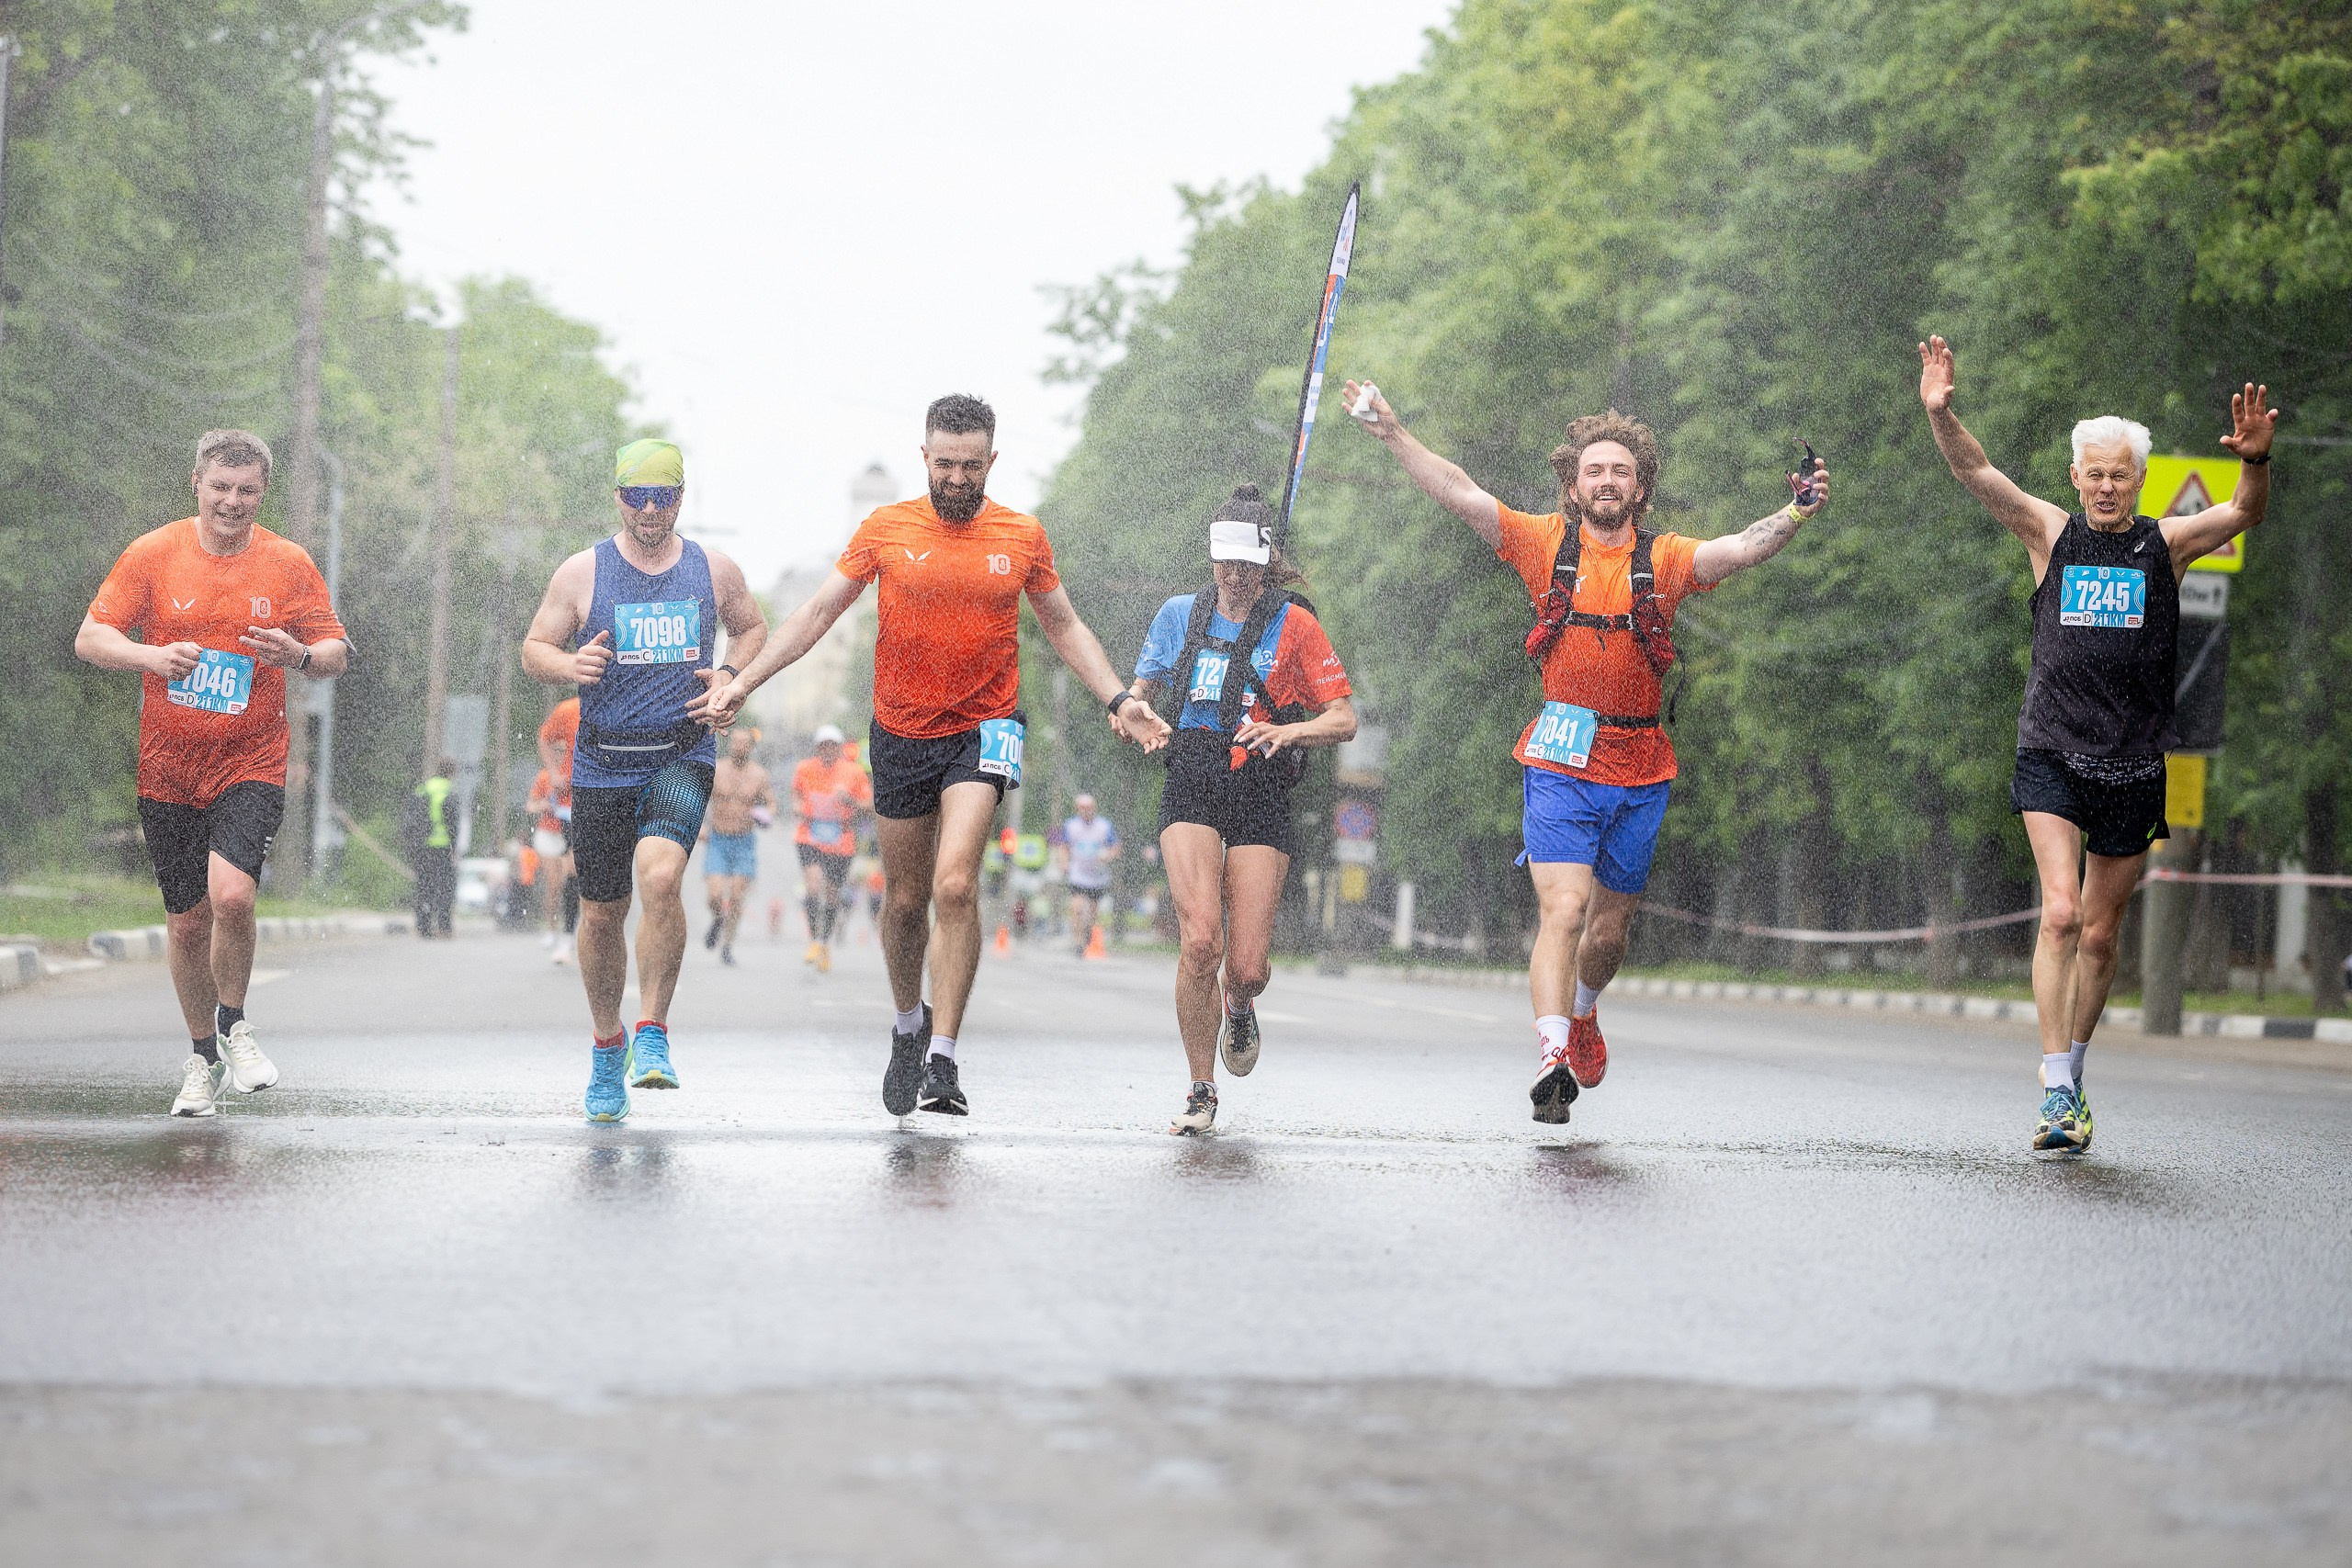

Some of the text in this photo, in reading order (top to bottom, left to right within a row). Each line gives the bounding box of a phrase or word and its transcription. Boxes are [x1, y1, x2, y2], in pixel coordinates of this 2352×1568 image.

[986, 553, 1011, 576] 10
[249, 596, 271, 619] 10
[2076, 580, 2131, 613] 7245
[2084, 614, 2092, 624] D
[629, 615, 687, 649] 7098
[187, 694, 195, 705] D
[1197, 688, 1204, 698] D
